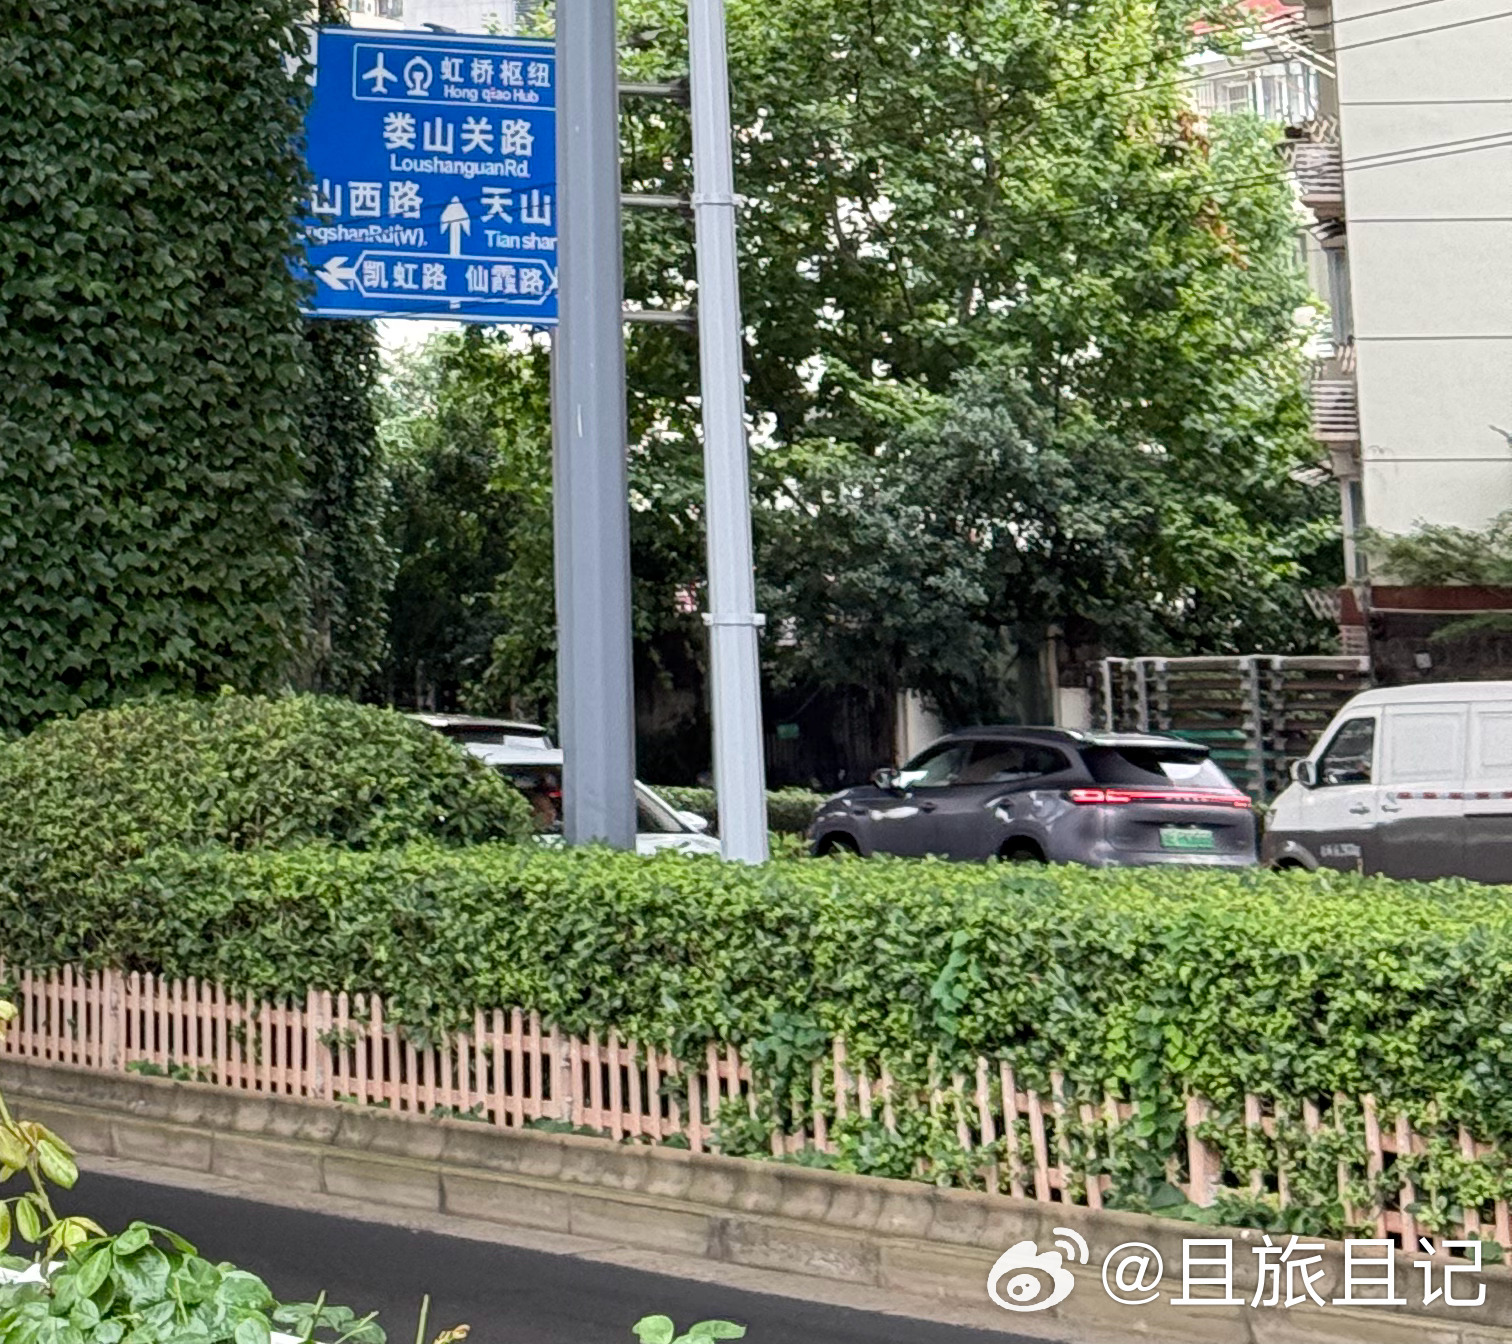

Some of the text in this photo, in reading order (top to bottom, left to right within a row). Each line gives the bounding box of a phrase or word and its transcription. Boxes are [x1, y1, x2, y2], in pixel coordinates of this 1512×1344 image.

[440, 56, 551, 88] 虹桥枢纽
[443, 84, 478, 102] Hong
[513, 88, 540, 103] Hub
[382, 111, 535, 157] 娄山关路
[291, 178, 424, 219] 山西路
[480, 186, 552, 227] 天山
[362, 260, 448, 291] 凯虹路
[464, 264, 545, 296] 仙霞路
